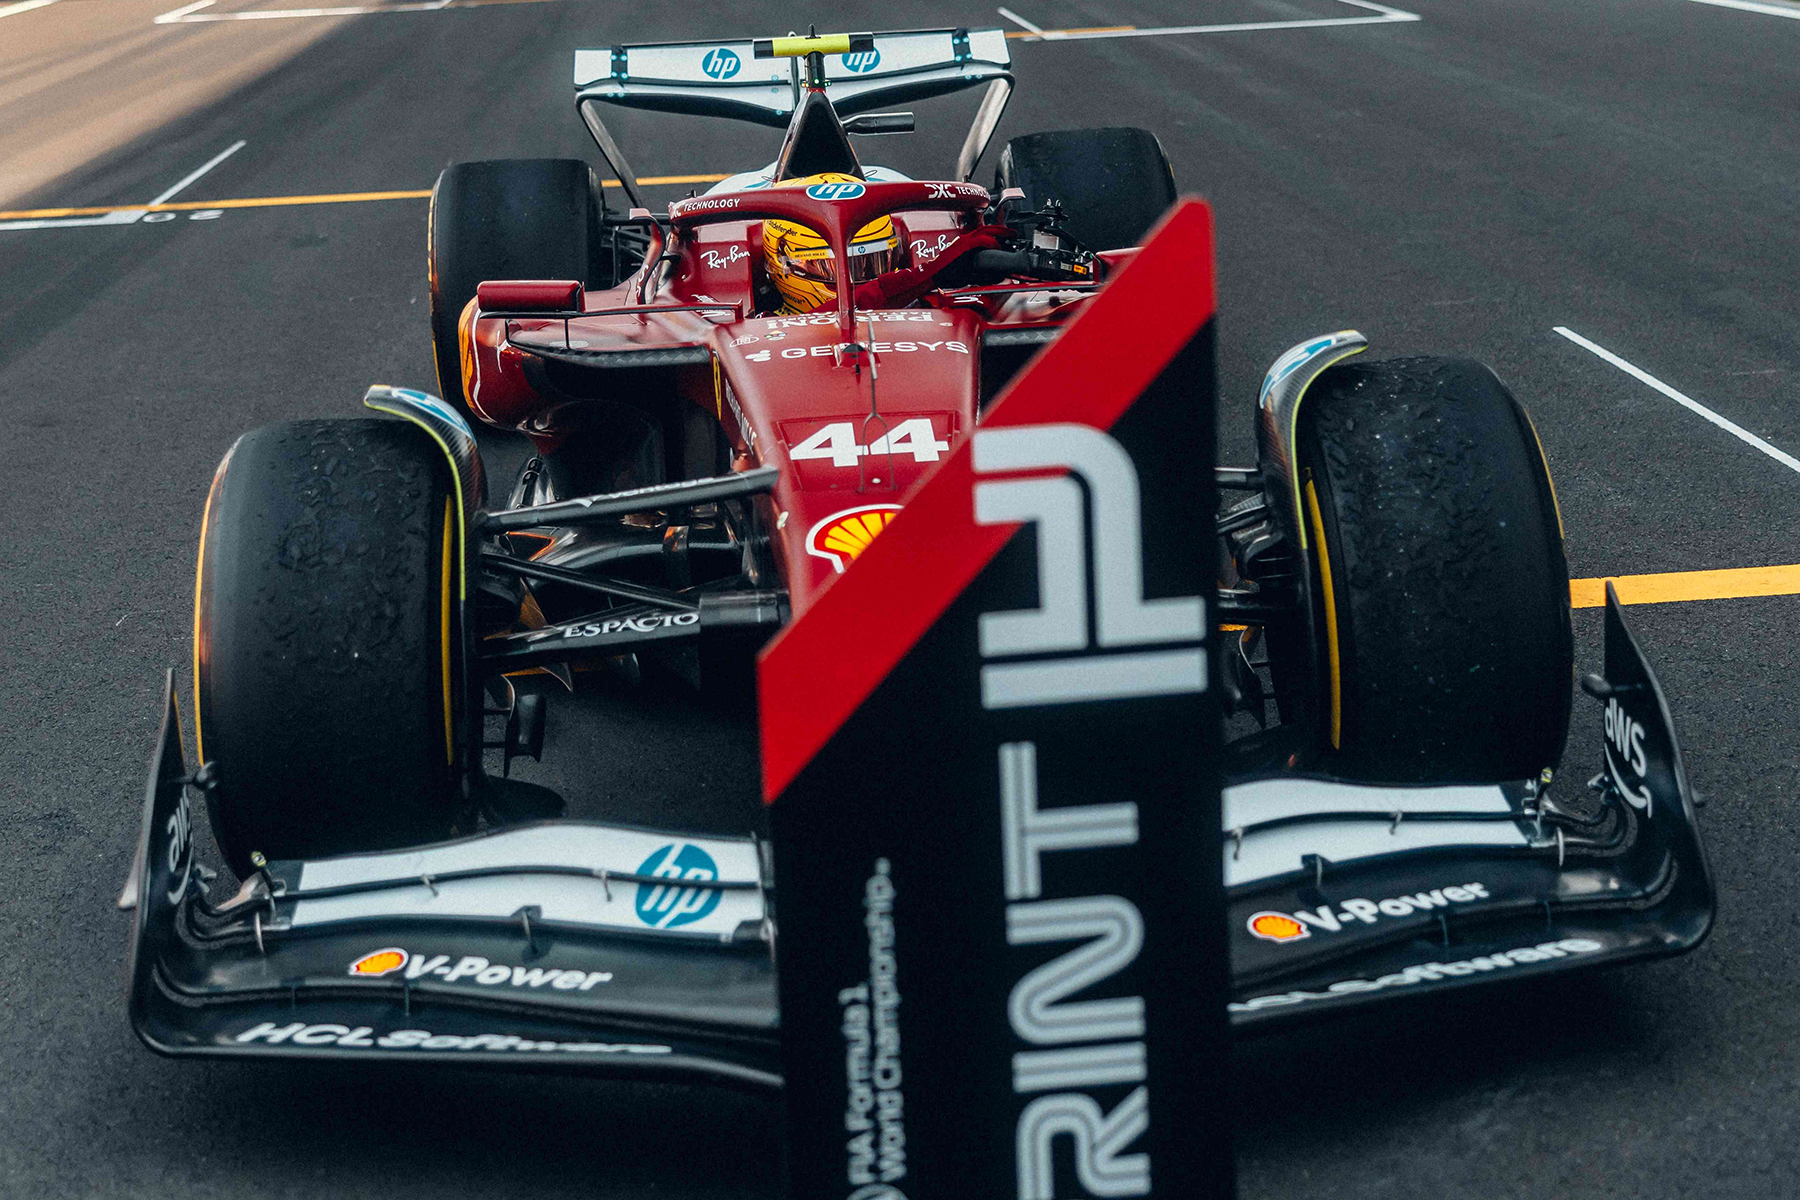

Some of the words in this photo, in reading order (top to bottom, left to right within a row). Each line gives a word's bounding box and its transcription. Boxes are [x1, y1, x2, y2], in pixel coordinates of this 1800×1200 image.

[707, 48, 738, 79] hp
[683, 198, 741, 212] TECHNOLOGY
[815, 183, 858, 200] hp
[700, 245, 750, 269] Ray-Ban
[789, 418, 950, 468] 44
[563, 612, 699, 638] ESPACIO
[641, 843, 715, 929] hp
[1294, 882, 1490, 932] V-Power
[405, 954, 613, 990] V-Power
[236, 1022, 374, 1047] HCL
[841, 1004, 876, 1132] Formula
[876, 1089, 907, 1183] World
